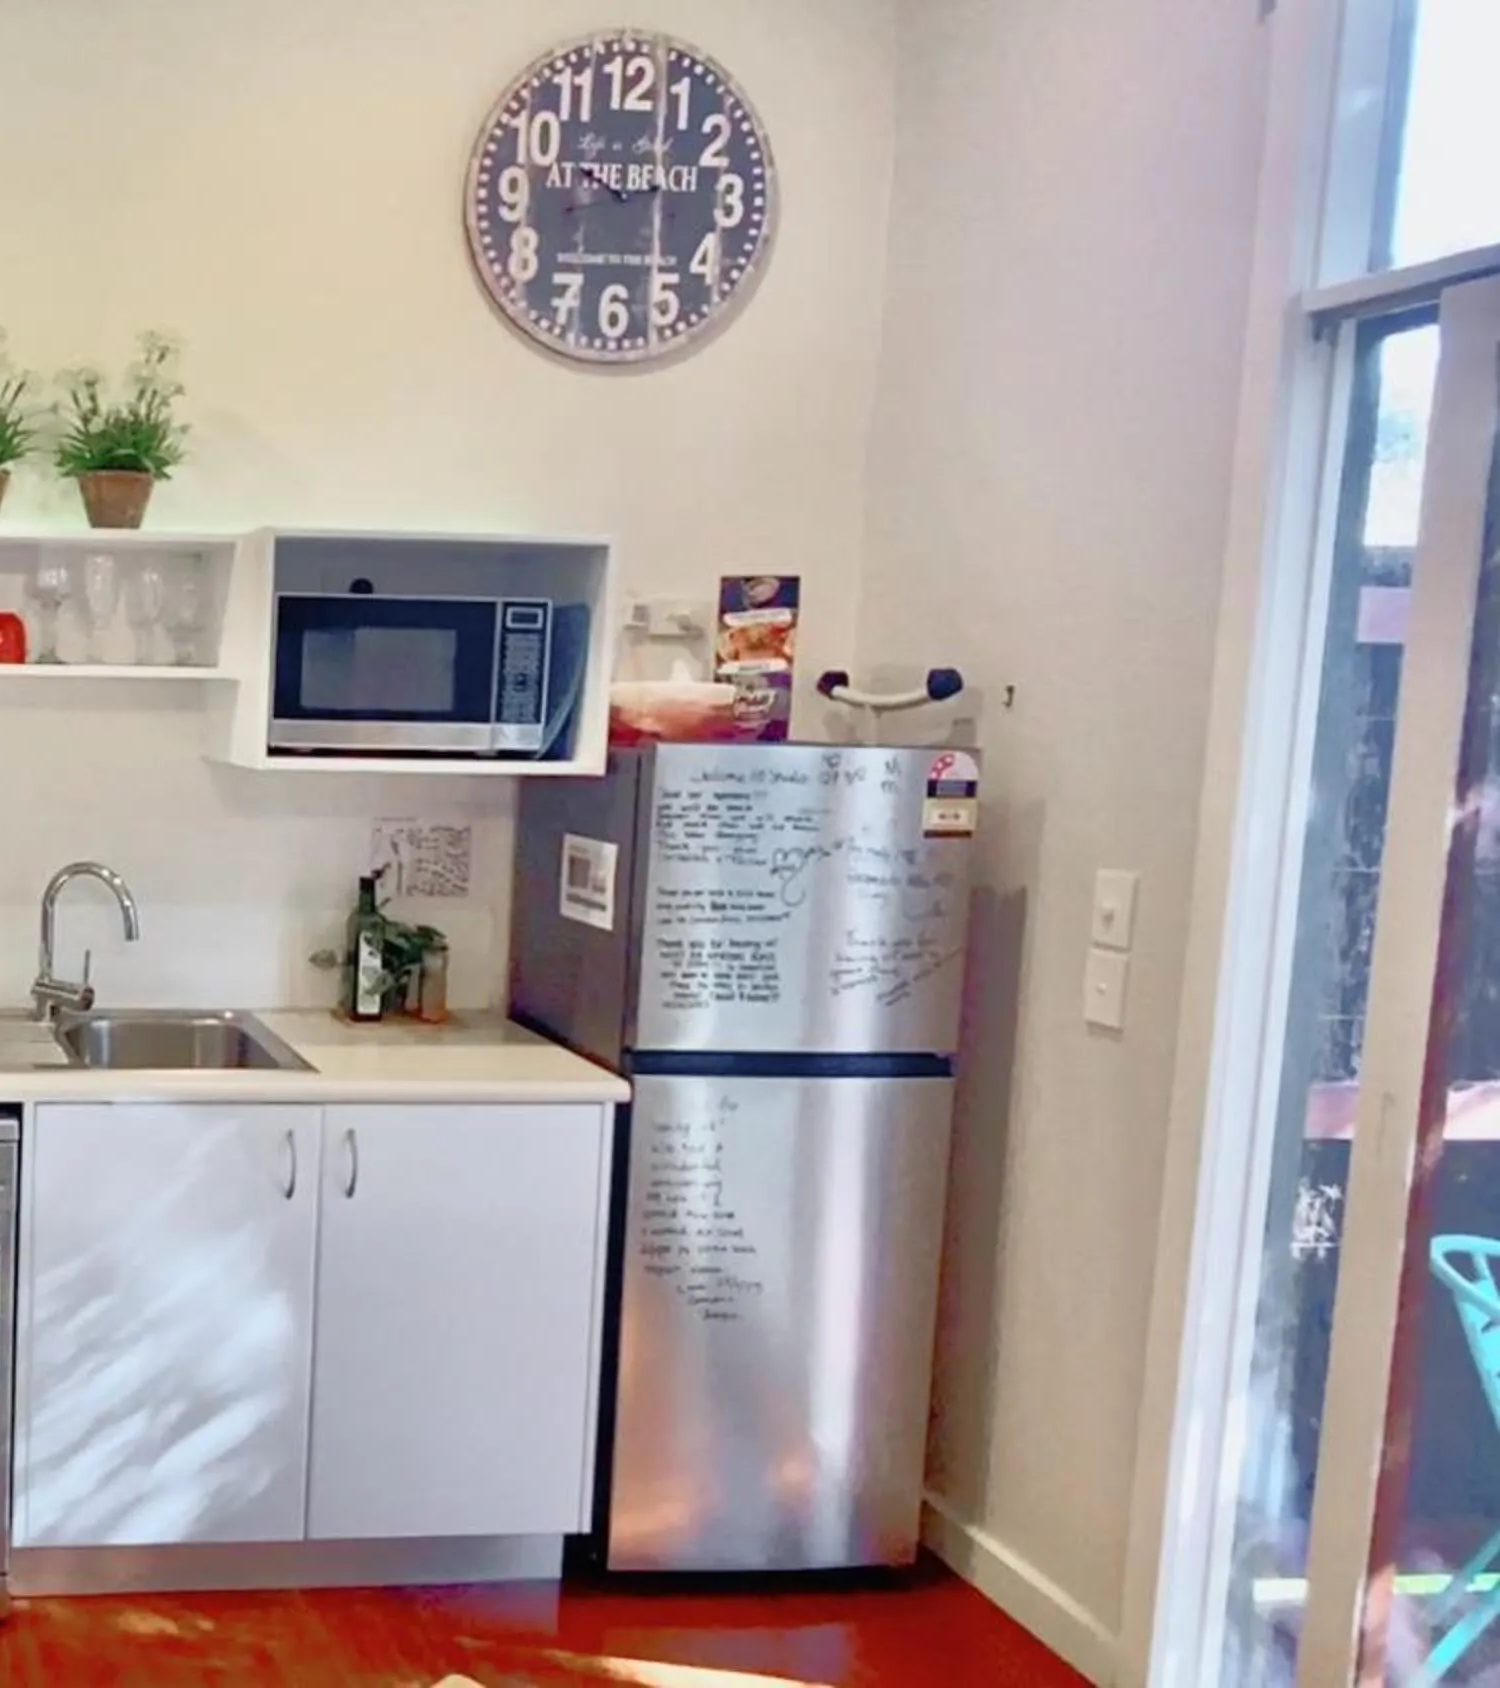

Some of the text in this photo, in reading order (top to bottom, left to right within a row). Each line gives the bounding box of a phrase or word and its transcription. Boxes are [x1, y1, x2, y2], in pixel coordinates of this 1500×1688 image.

[553, 67, 591, 122] 11
[603, 56, 655, 111] 12
[671, 77, 691, 130] 1
[508, 109, 561, 166] 10
[699, 114, 731, 168] 2
[499, 167, 529, 222] 9
[545, 162, 698, 192] AT THE BEACH
[714, 173, 744, 228] 3
[508, 226, 538, 282] 8
[690, 233, 717, 285] 4
[551, 273, 584, 325] 7
[599, 285, 629, 338] 6
[653, 273, 680, 325] 5
